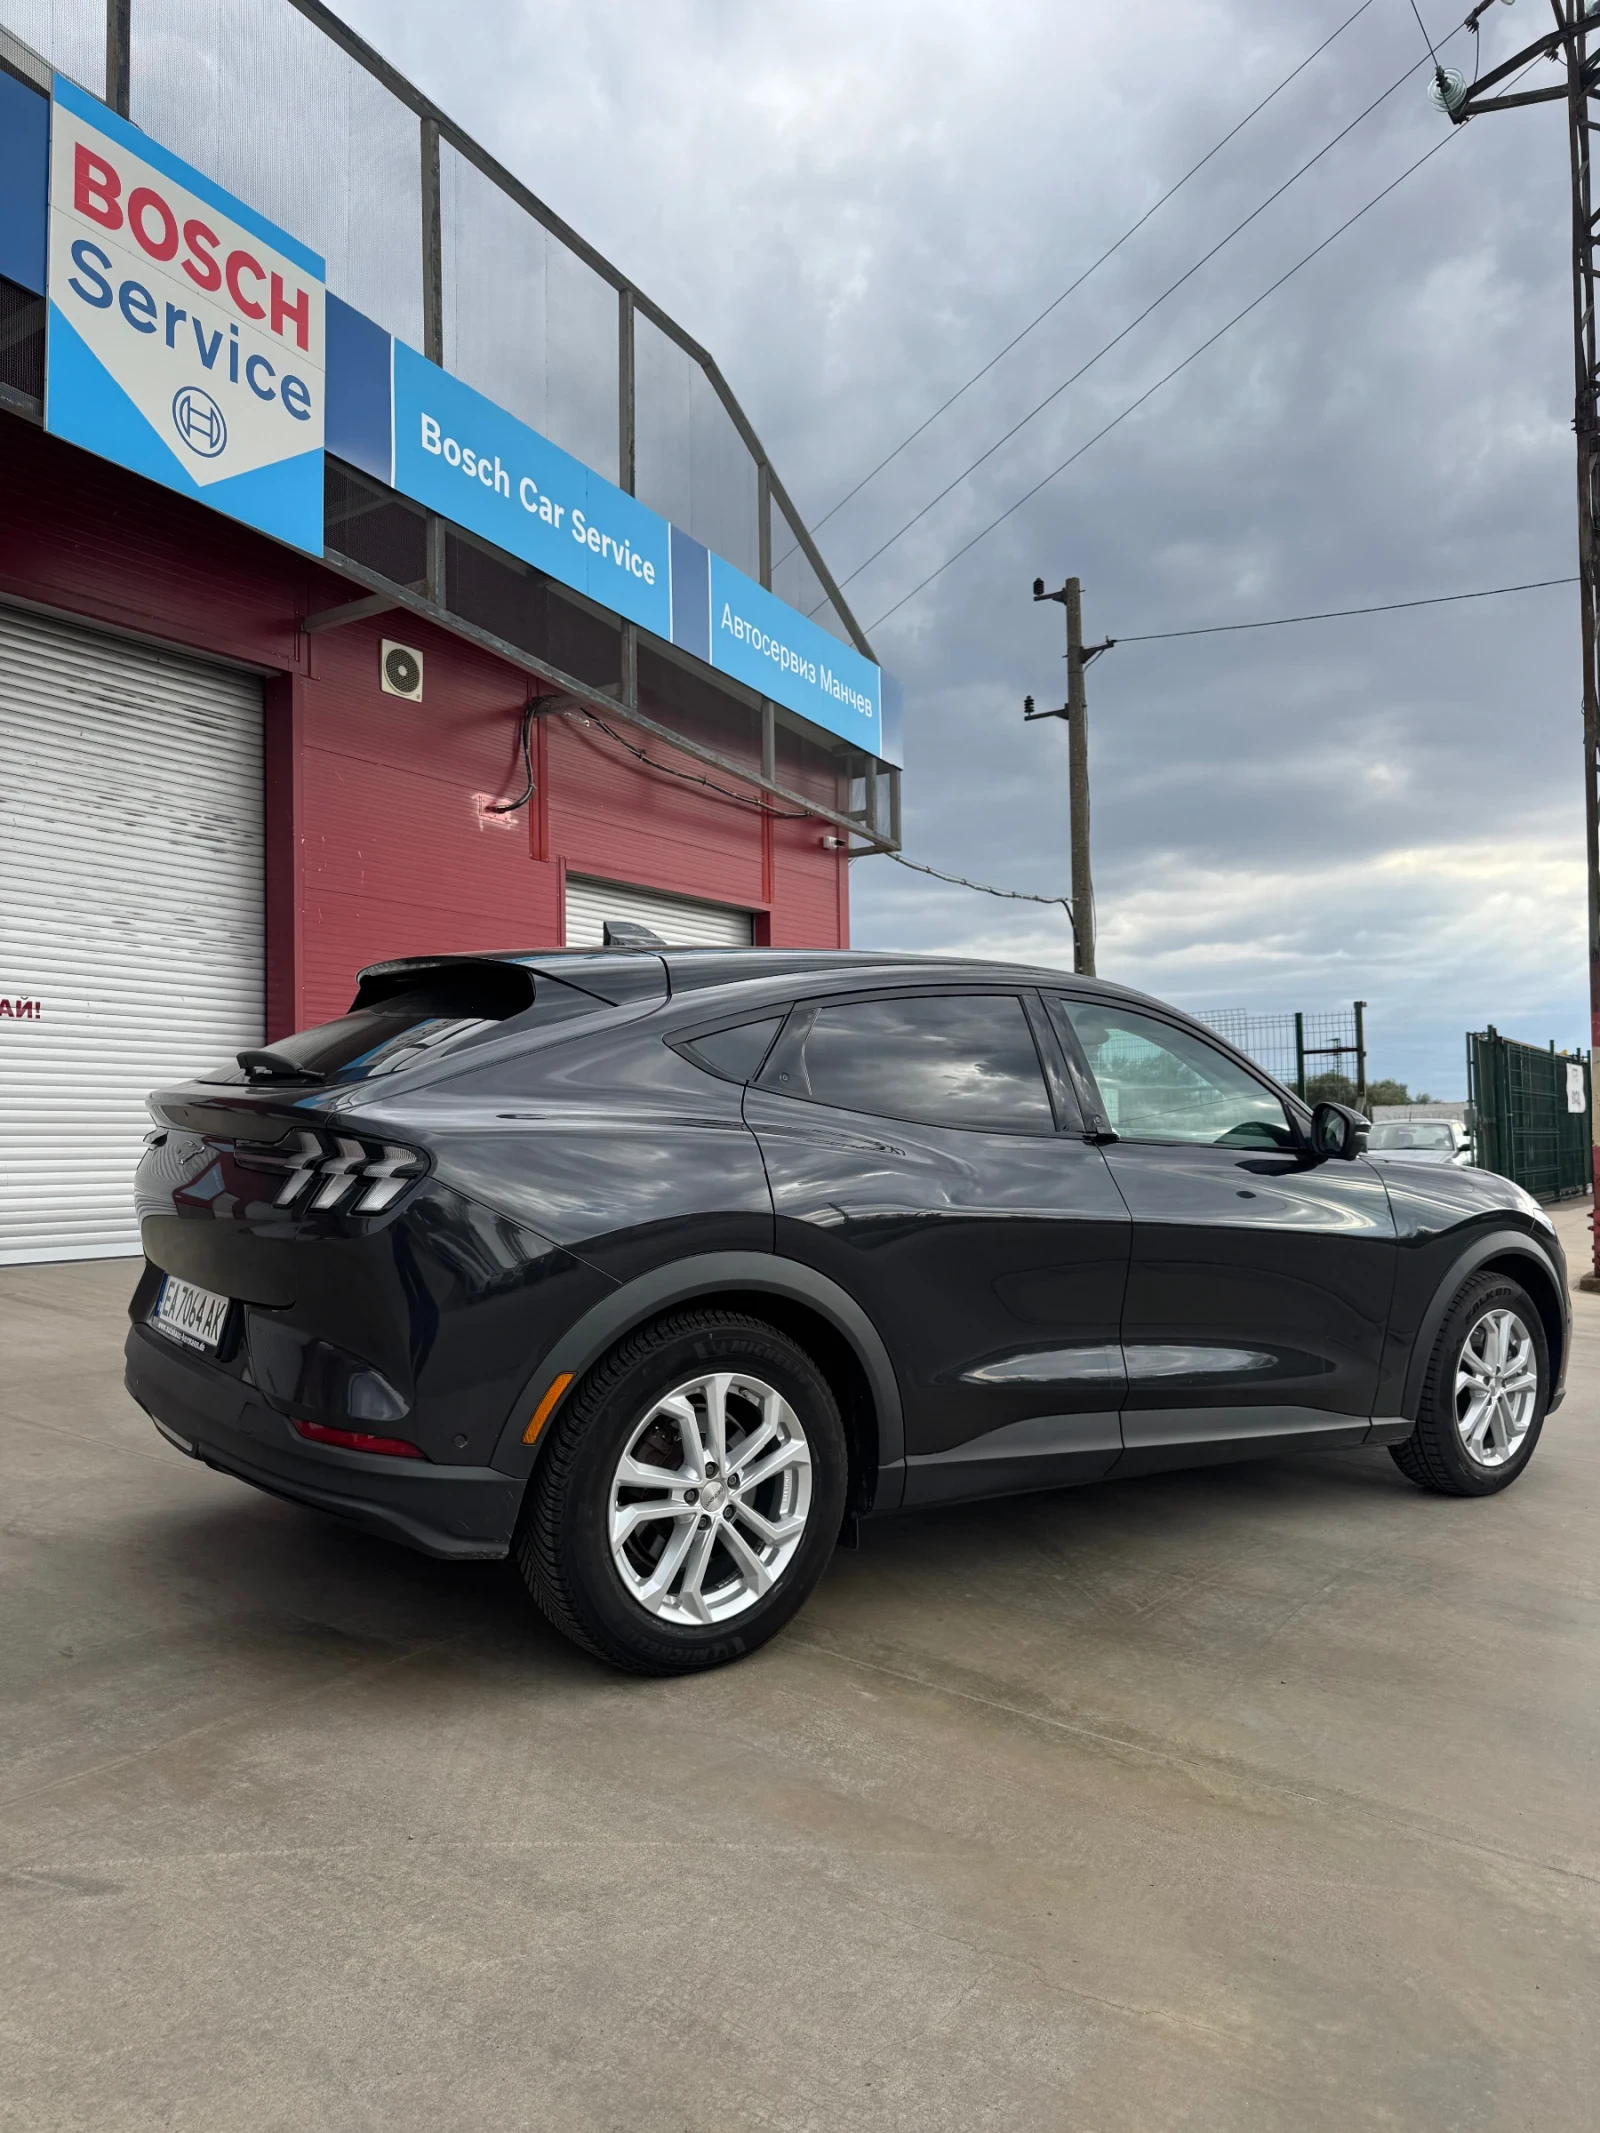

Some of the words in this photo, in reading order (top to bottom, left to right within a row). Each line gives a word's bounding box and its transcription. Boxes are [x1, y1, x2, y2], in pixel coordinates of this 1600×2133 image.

[67, 239, 312, 421] Service
[74, 141, 310, 352] BOSCH
[421, 412, 510, 499] Bosch
[520, 477, 565, 529] Car
[572, 508, 656, 585] Service
[721, 602, 816, 684] Автосервиз
[820, 664, 873, 718] Манчев
